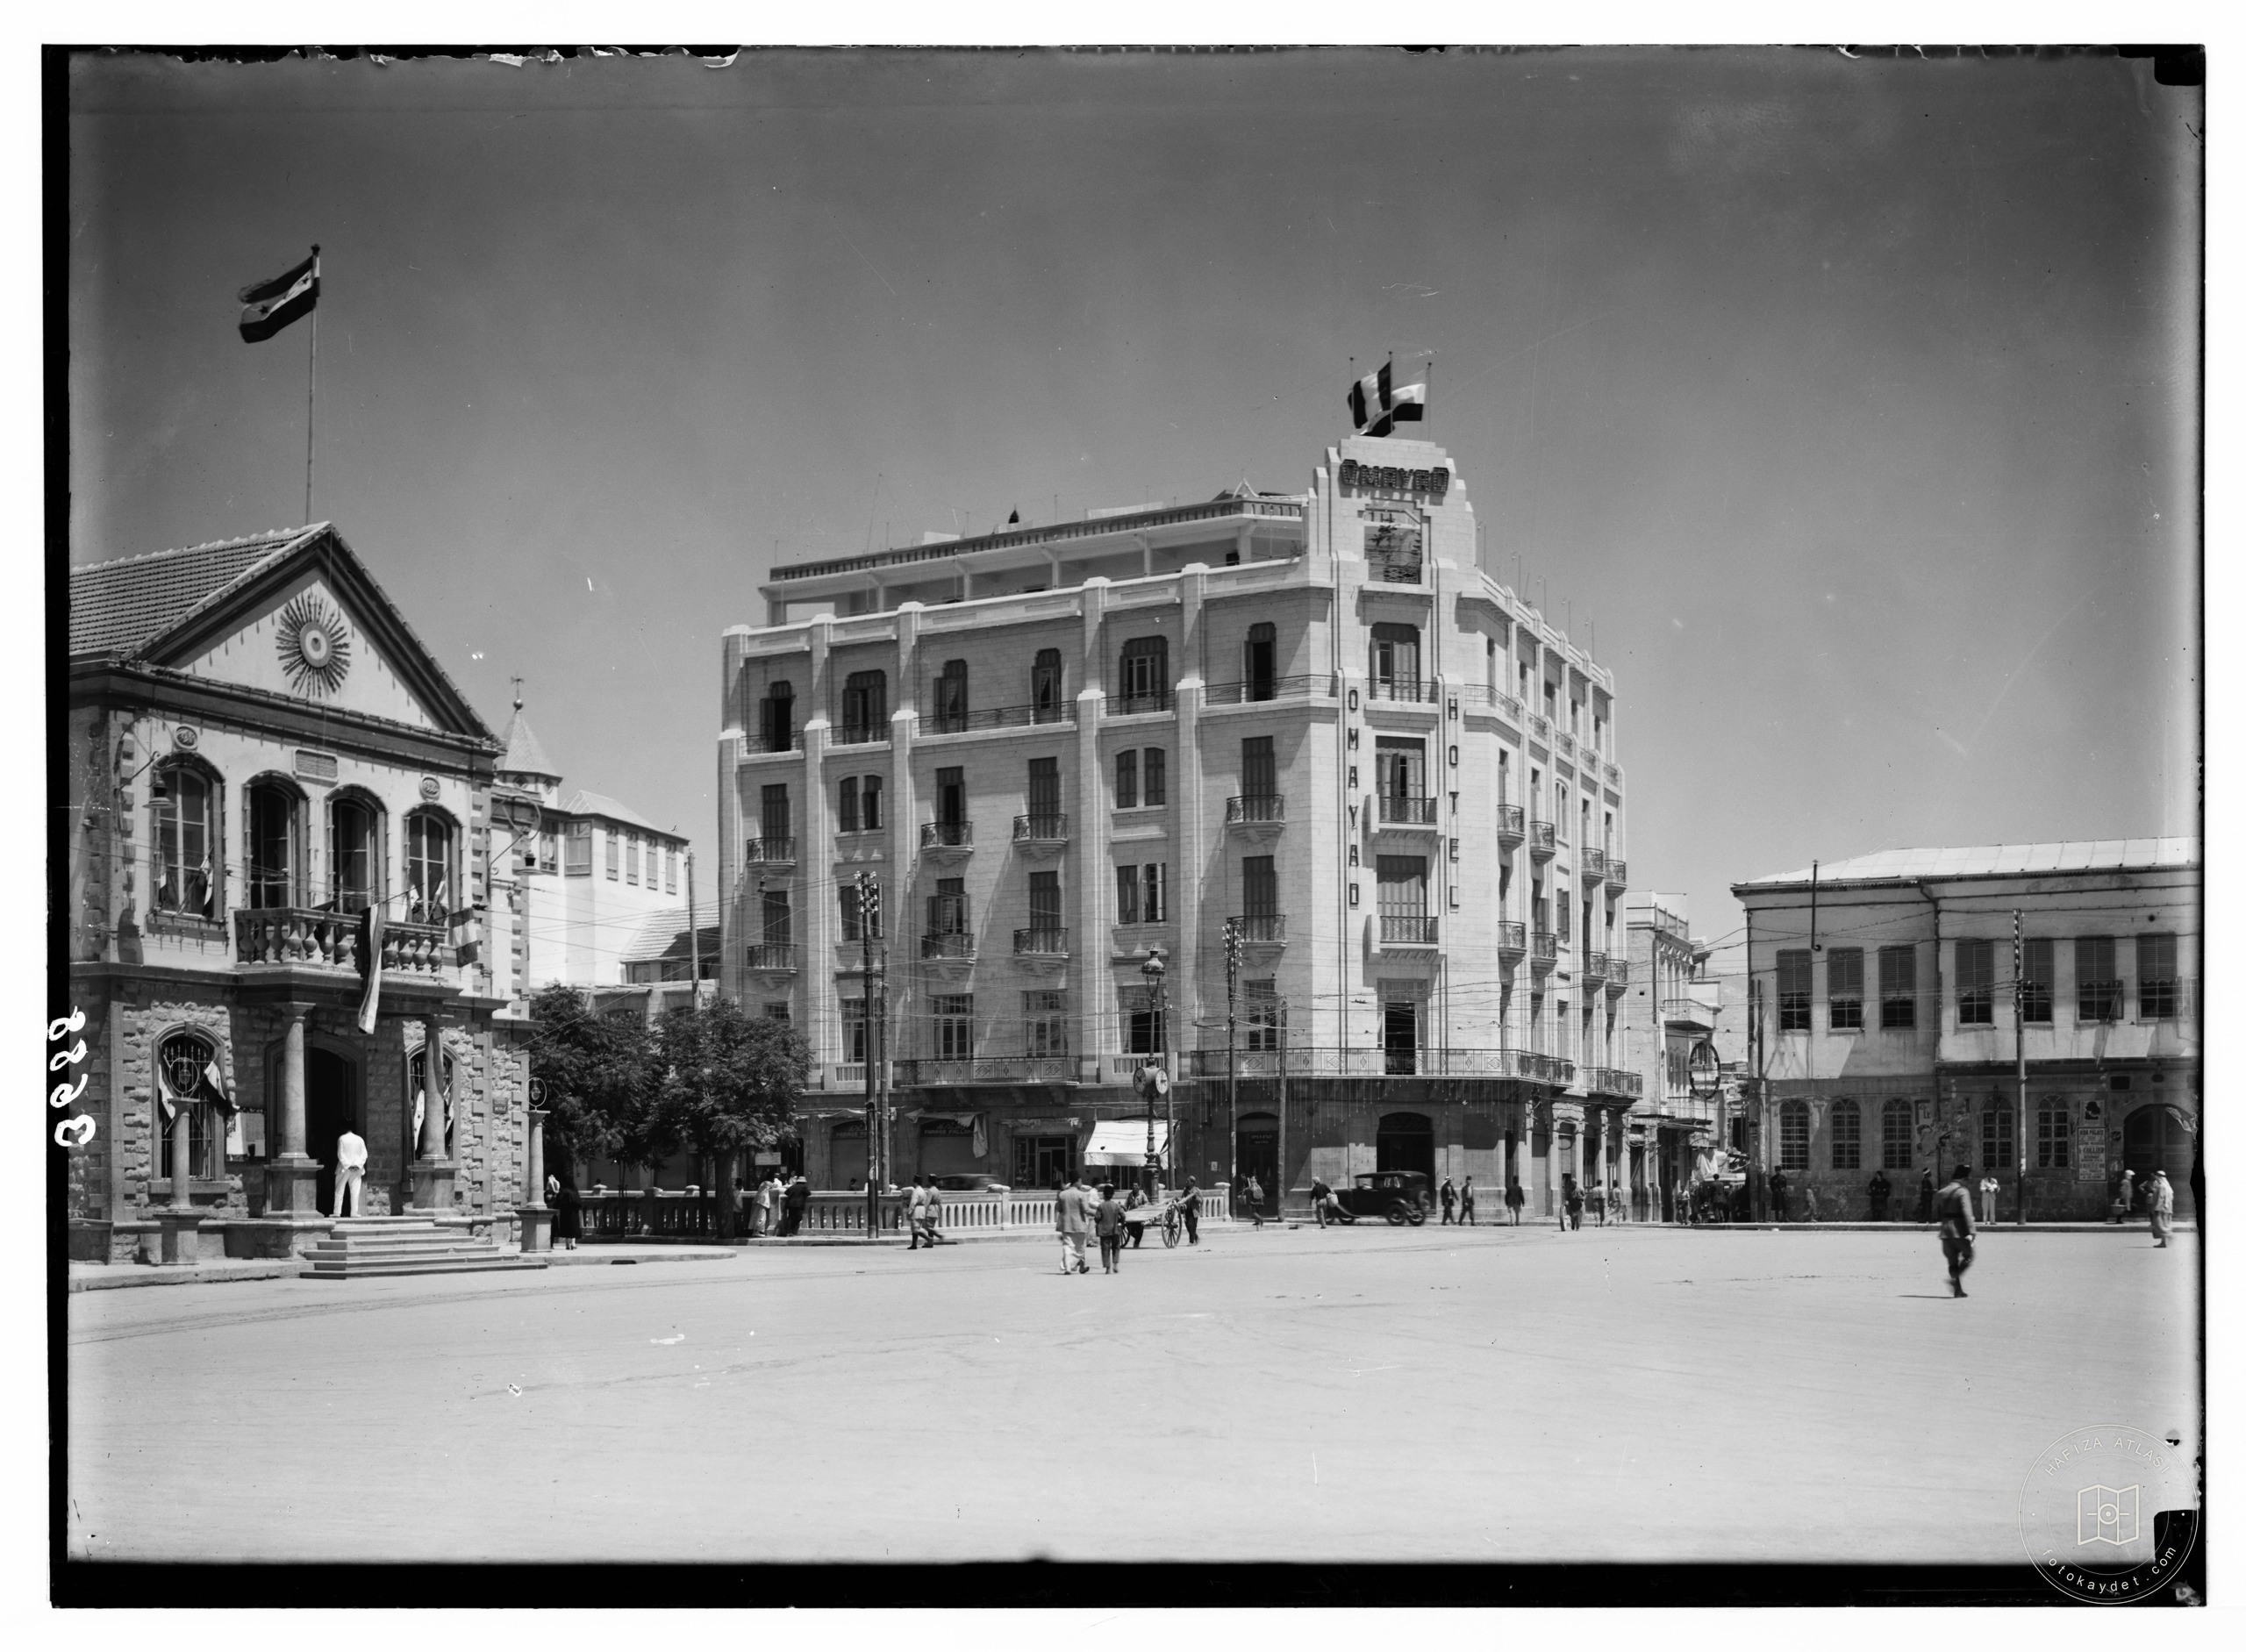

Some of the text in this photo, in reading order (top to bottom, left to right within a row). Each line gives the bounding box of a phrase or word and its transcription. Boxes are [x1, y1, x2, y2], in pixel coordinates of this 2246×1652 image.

[1340, 458, 1449, 493] OMAYAD
[1348, 689, 1359, 905] OMAYAD
[1448, 697, 1460, 907] HOTEL
